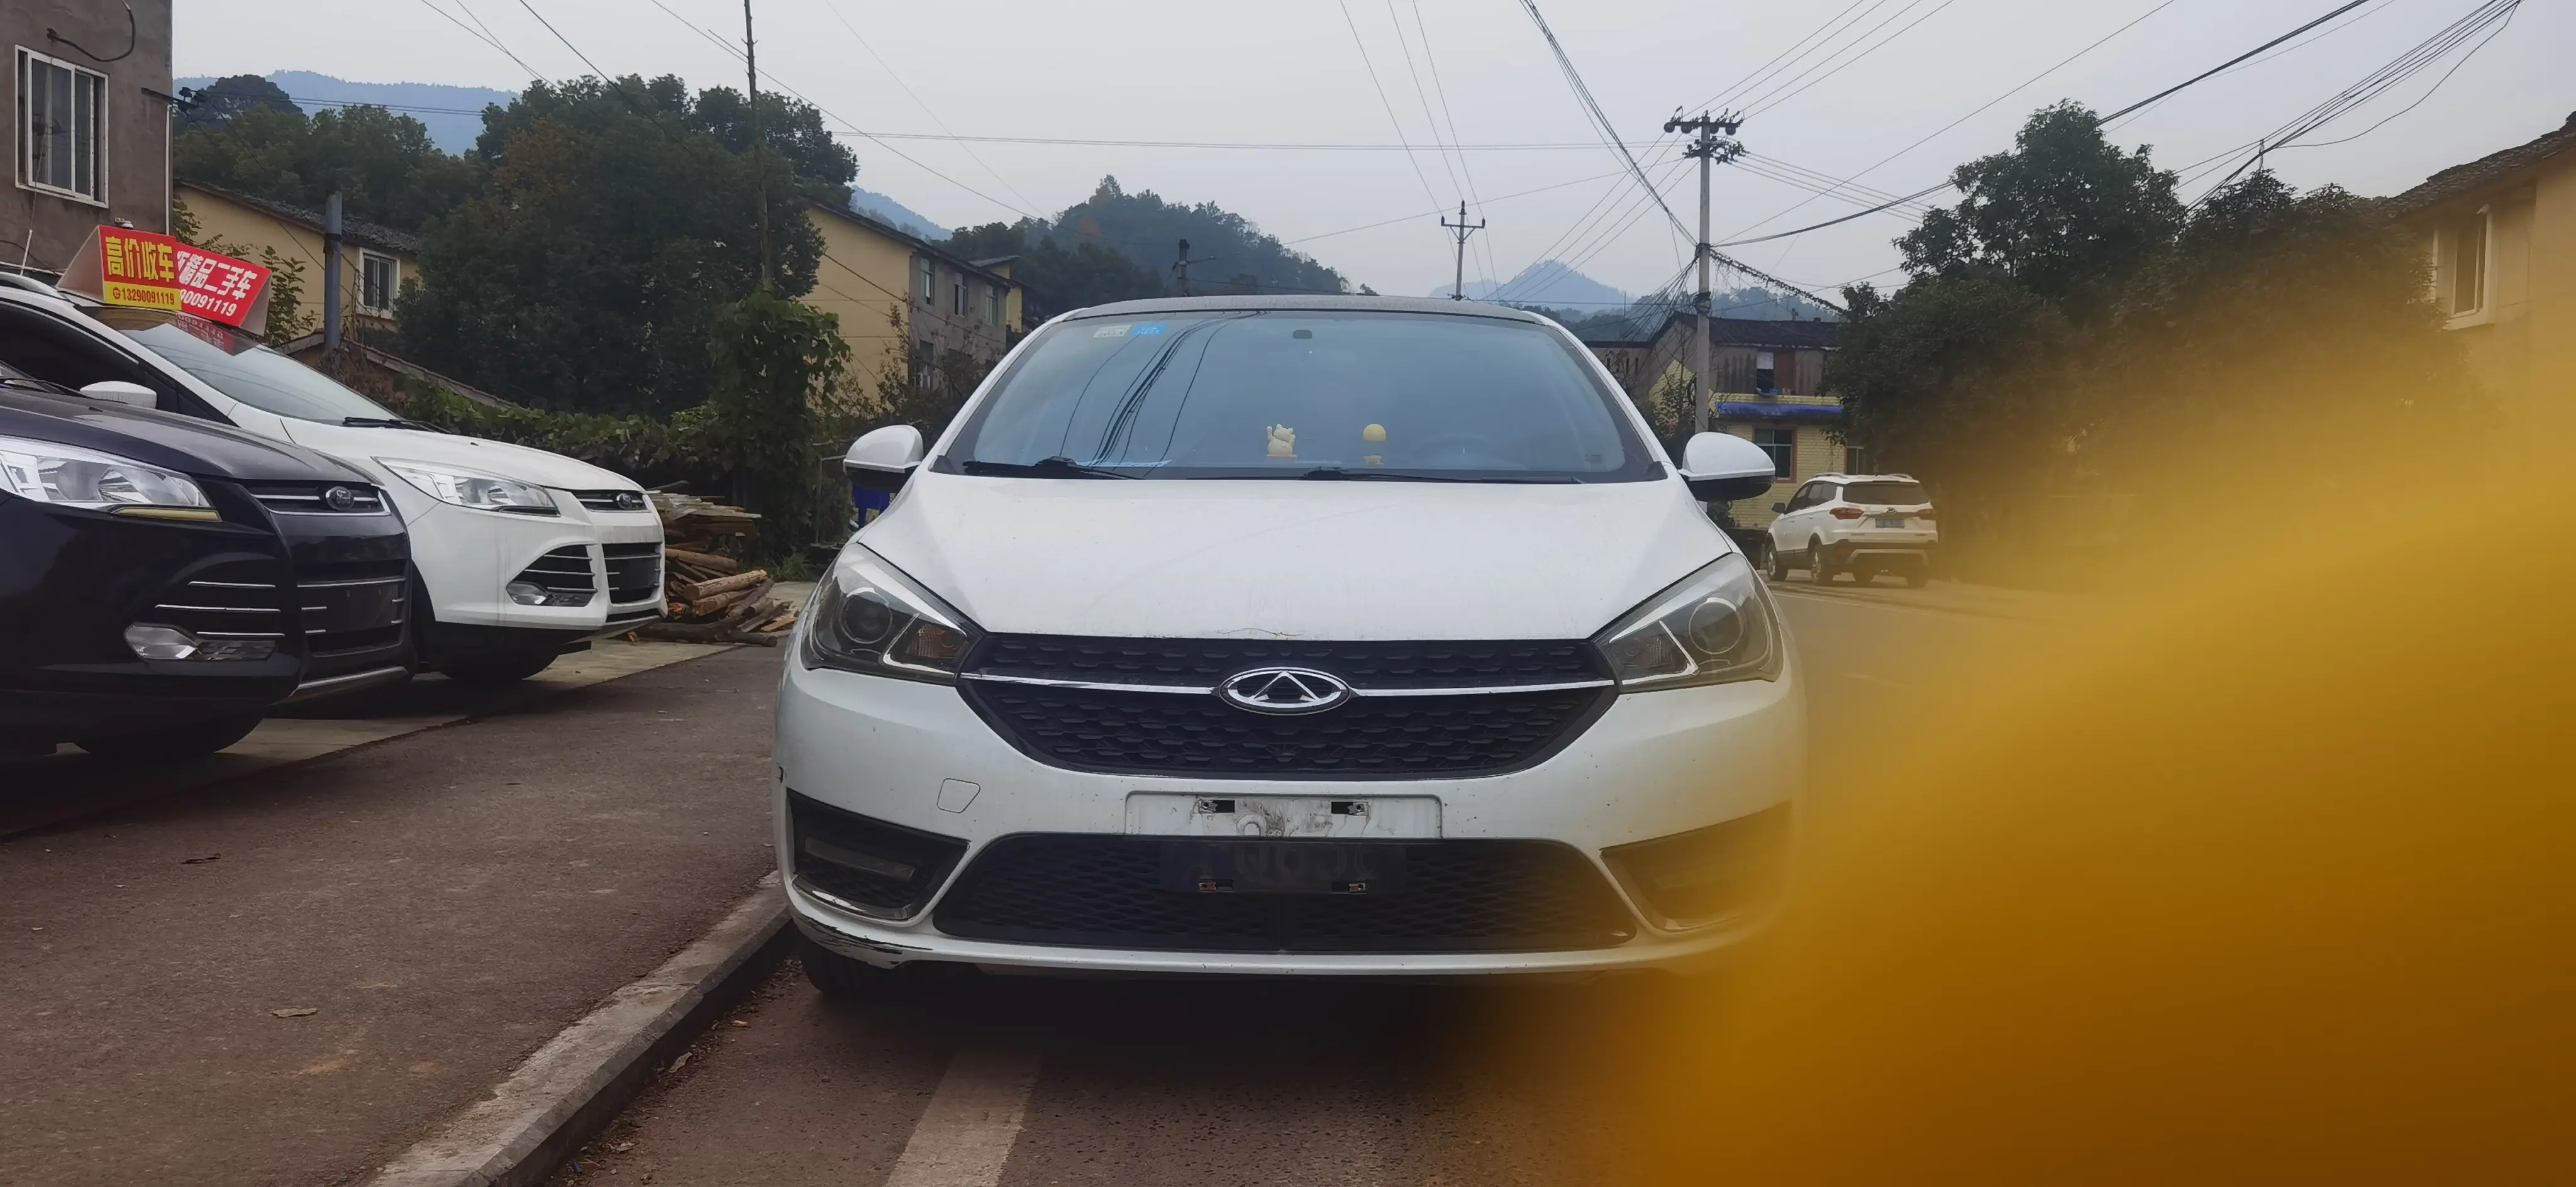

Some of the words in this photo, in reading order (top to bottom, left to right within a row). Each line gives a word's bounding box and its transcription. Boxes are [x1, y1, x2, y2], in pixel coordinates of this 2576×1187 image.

[105, 236, 175, 282] 高价收车
[122, 288, 175, 305] 13290091119
